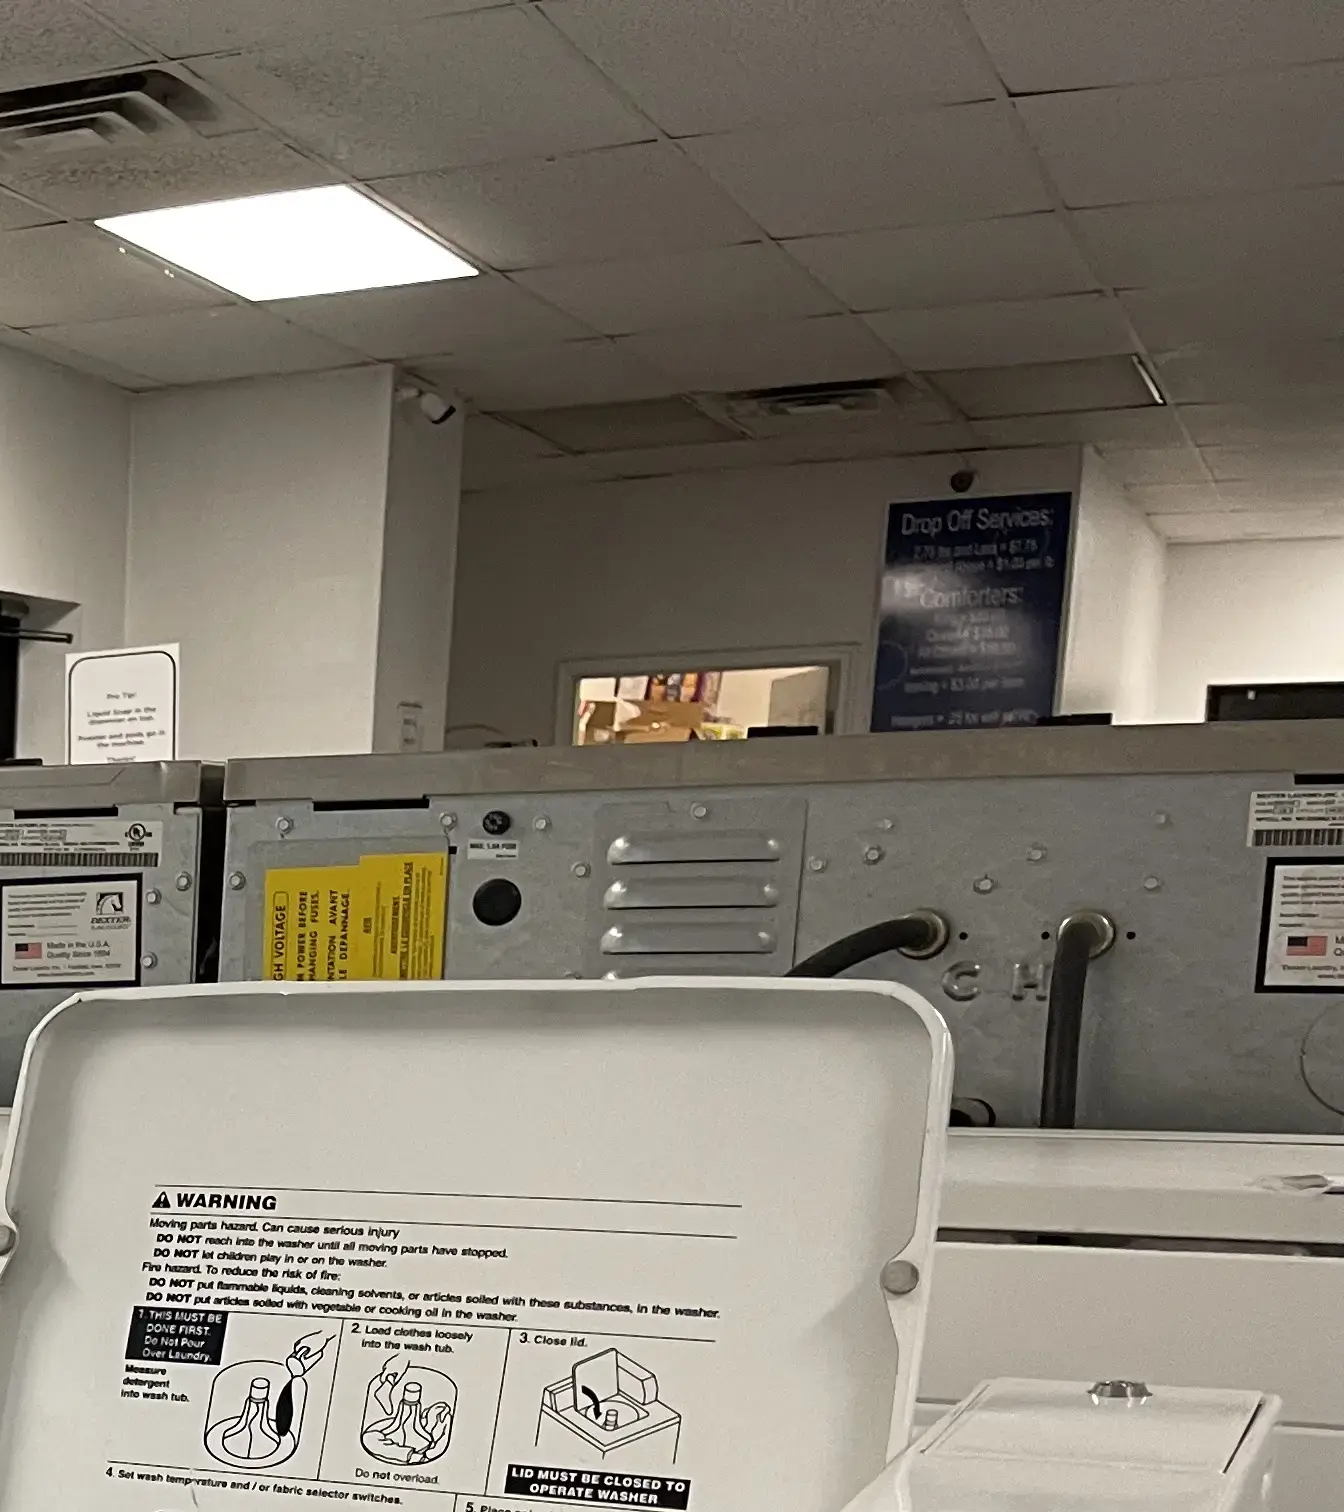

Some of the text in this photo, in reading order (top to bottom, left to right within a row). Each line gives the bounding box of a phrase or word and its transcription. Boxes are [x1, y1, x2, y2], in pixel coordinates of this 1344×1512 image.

[902, 513, 941, 538] Drop
[948, 509, 973, 532] Off
[329, 890, 338, 925] AVANT
[274, 905, 286, 959] VOLTAGE
[297, 891, 308, 971] POWER BEFORE
[177, 1193, 276, 1210] WARNING
[149, 1217, 400, 1239] Moving parts hazard. Can cause serious injury
[153, 1247, 170, 1257] DO
[173, 1248, 199, 1258] NOT
[201, 1249, 214, 1259] let
[216, 1251, 257, 1261] children
[259, 1253, 282, 1265] play
[283, 1253, 294, 1263] in
[328, 1256, 345, 1265] the
[156, 1233, 508, 1259] DO NOT reach into the washer until all moving parts have stopped.
[149, 1310, 172, 1321] THIS
[174, 1311, 206, 1322] MUST
[207, 1313, 223, 1324] BE
[350, 1322, 473, 1342] 2. Load clothes loosely
[519, 1332, 587, 1347] 3. Close lid.
[361, 1339, 454, 1353] into the wash tub.
[354, 1467, 370, 1478] Do
[372, 1471, 390, 1480] not
[511, 1467, 686, 1492] LID MUST BE CLOSED TO
[529, 1483, 657, 1503] OPERATE WASHER
